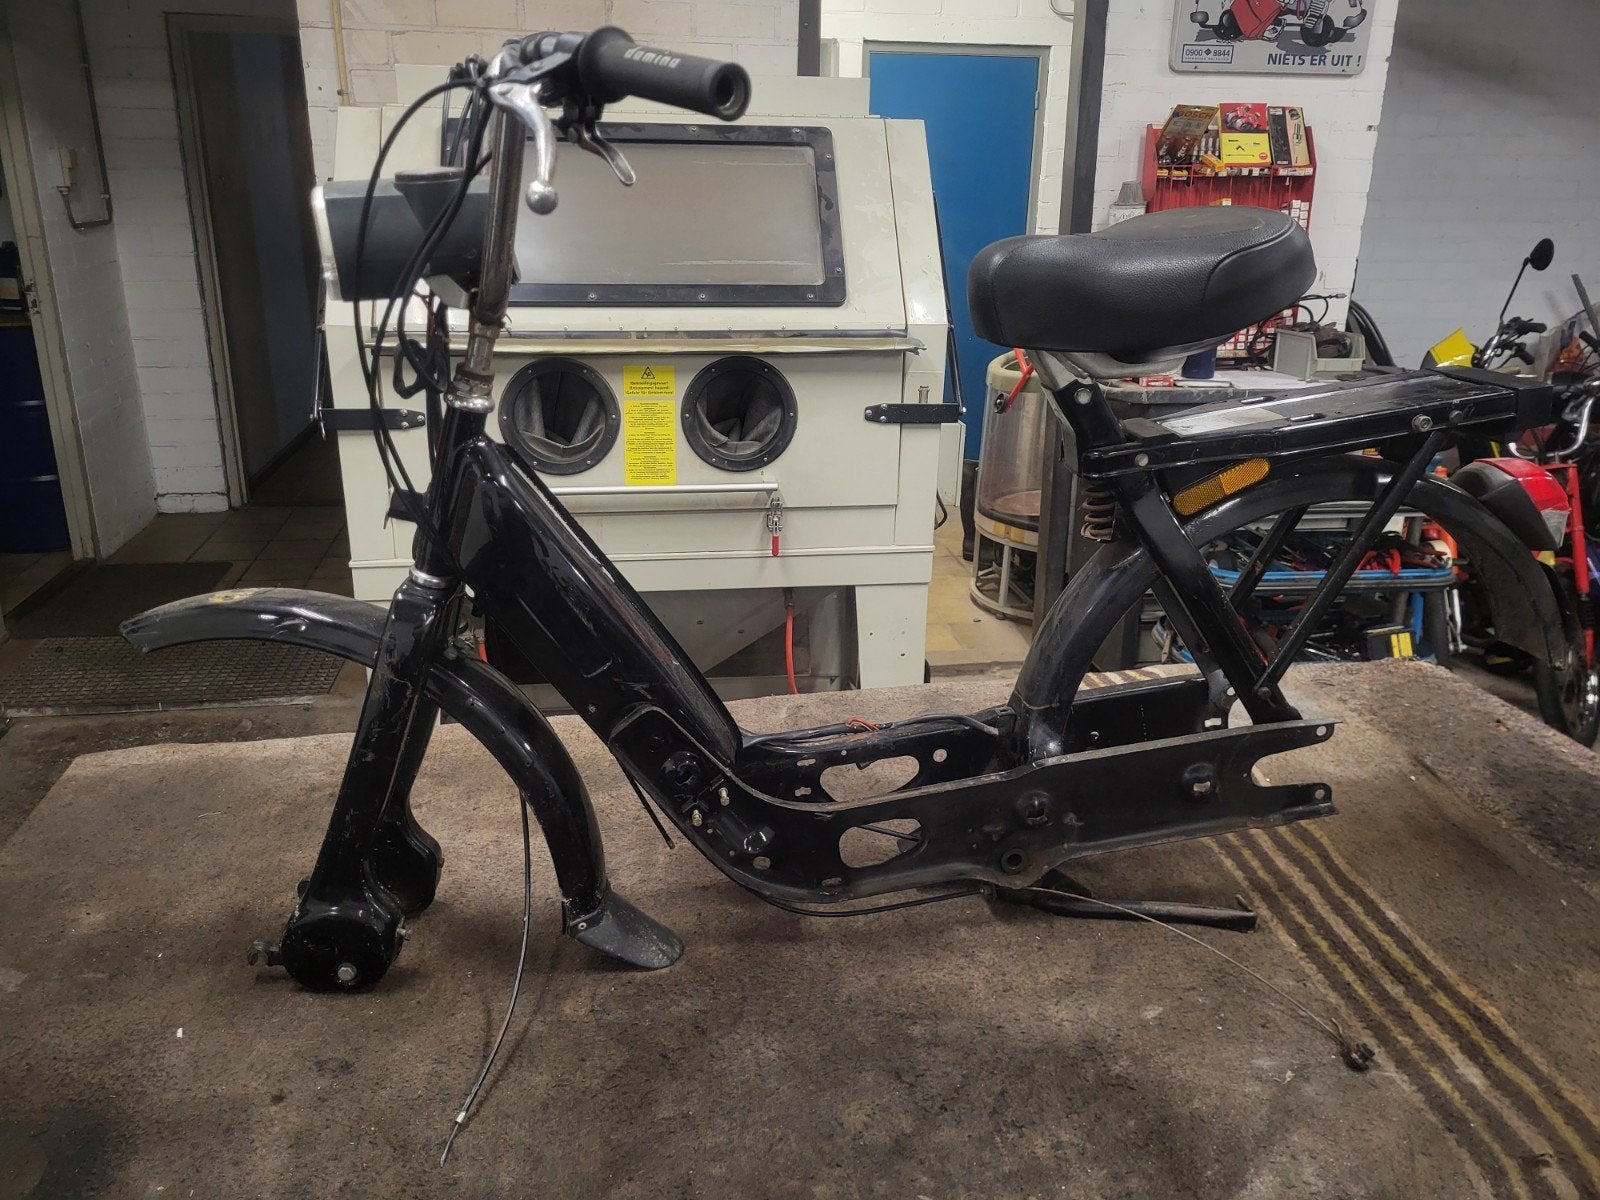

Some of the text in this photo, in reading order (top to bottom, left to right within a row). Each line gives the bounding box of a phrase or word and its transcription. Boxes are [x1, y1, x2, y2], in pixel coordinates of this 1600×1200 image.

[1185, 49, 1230, 57] 0900 8844
[1267, 53, 1362, 67] NIETS ER UIT !
